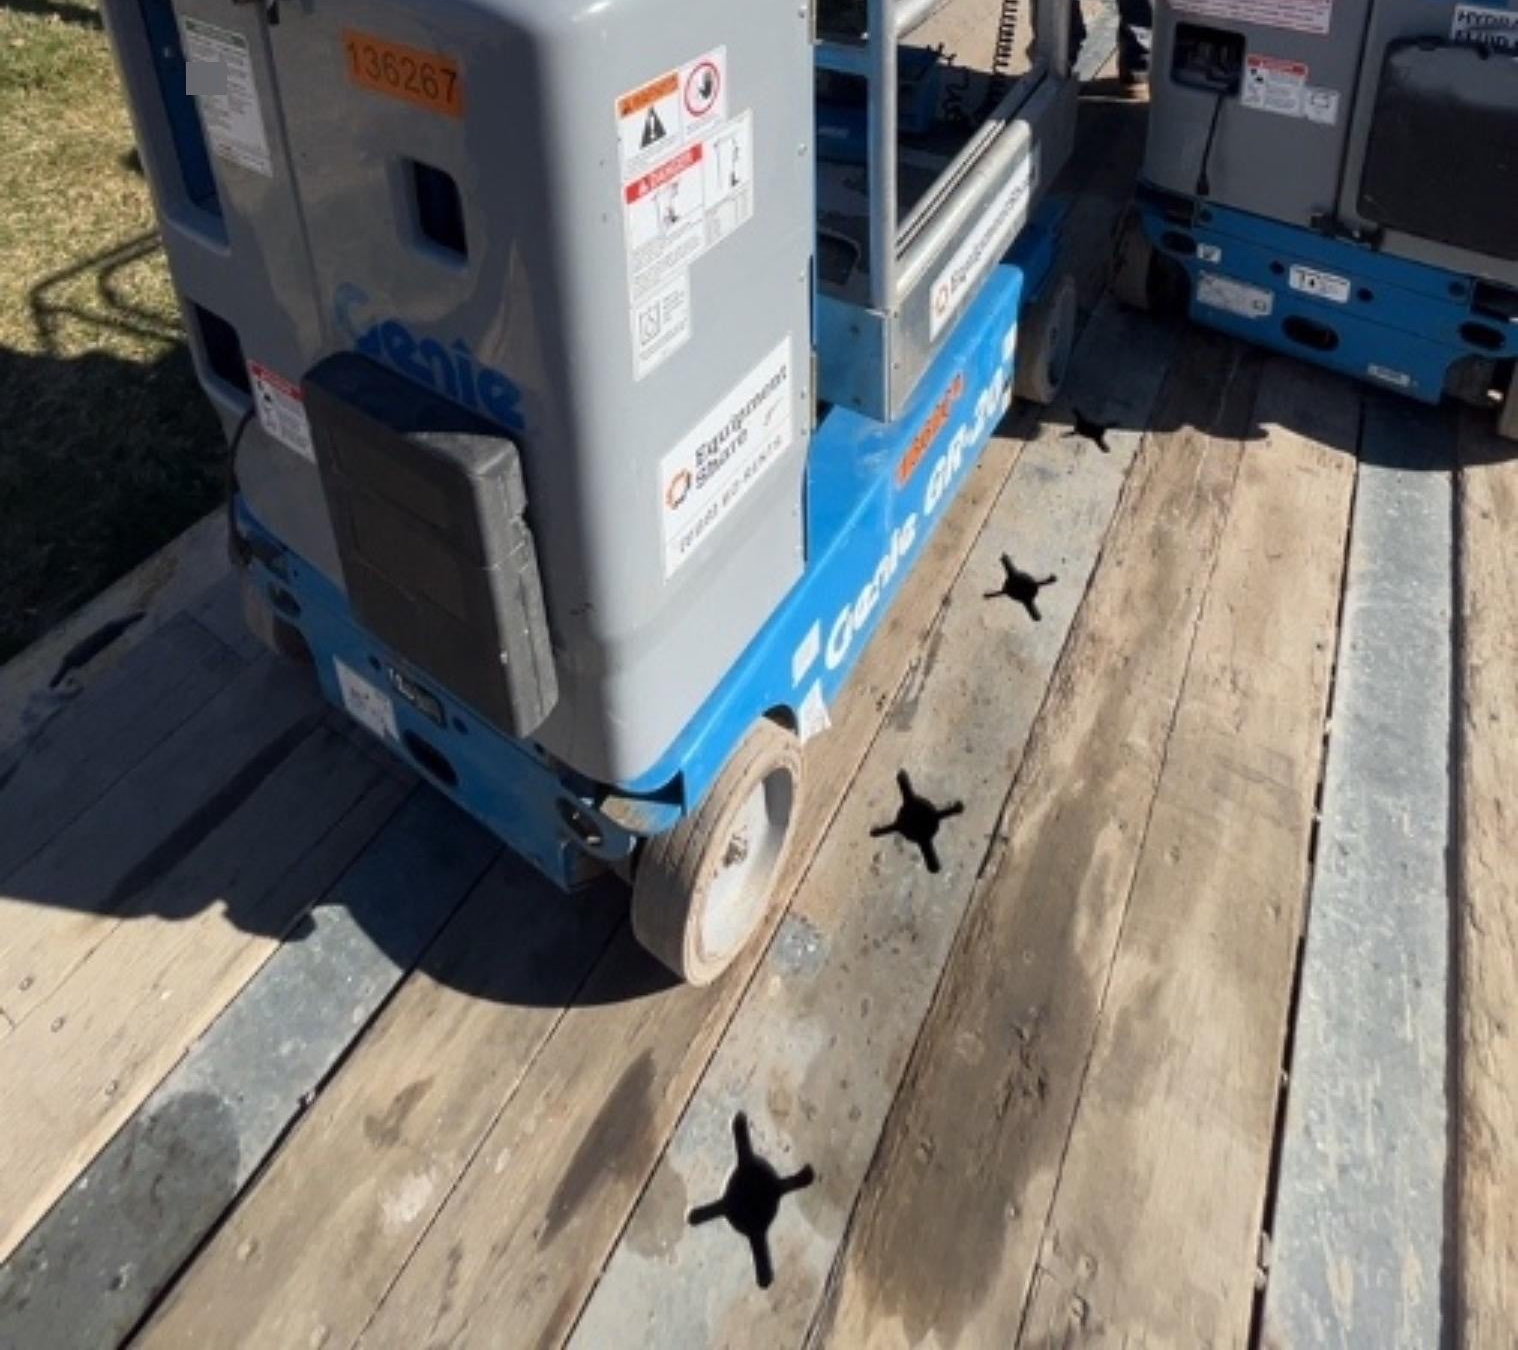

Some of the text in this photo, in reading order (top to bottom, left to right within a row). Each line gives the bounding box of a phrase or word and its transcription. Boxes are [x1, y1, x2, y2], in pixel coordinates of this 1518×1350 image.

[345, 40, 457, 104] 136267
[695, 365, 786, 468] Equipment
[695, 428, 748, 489] Share
[825, 511, 919, 672] Genie
